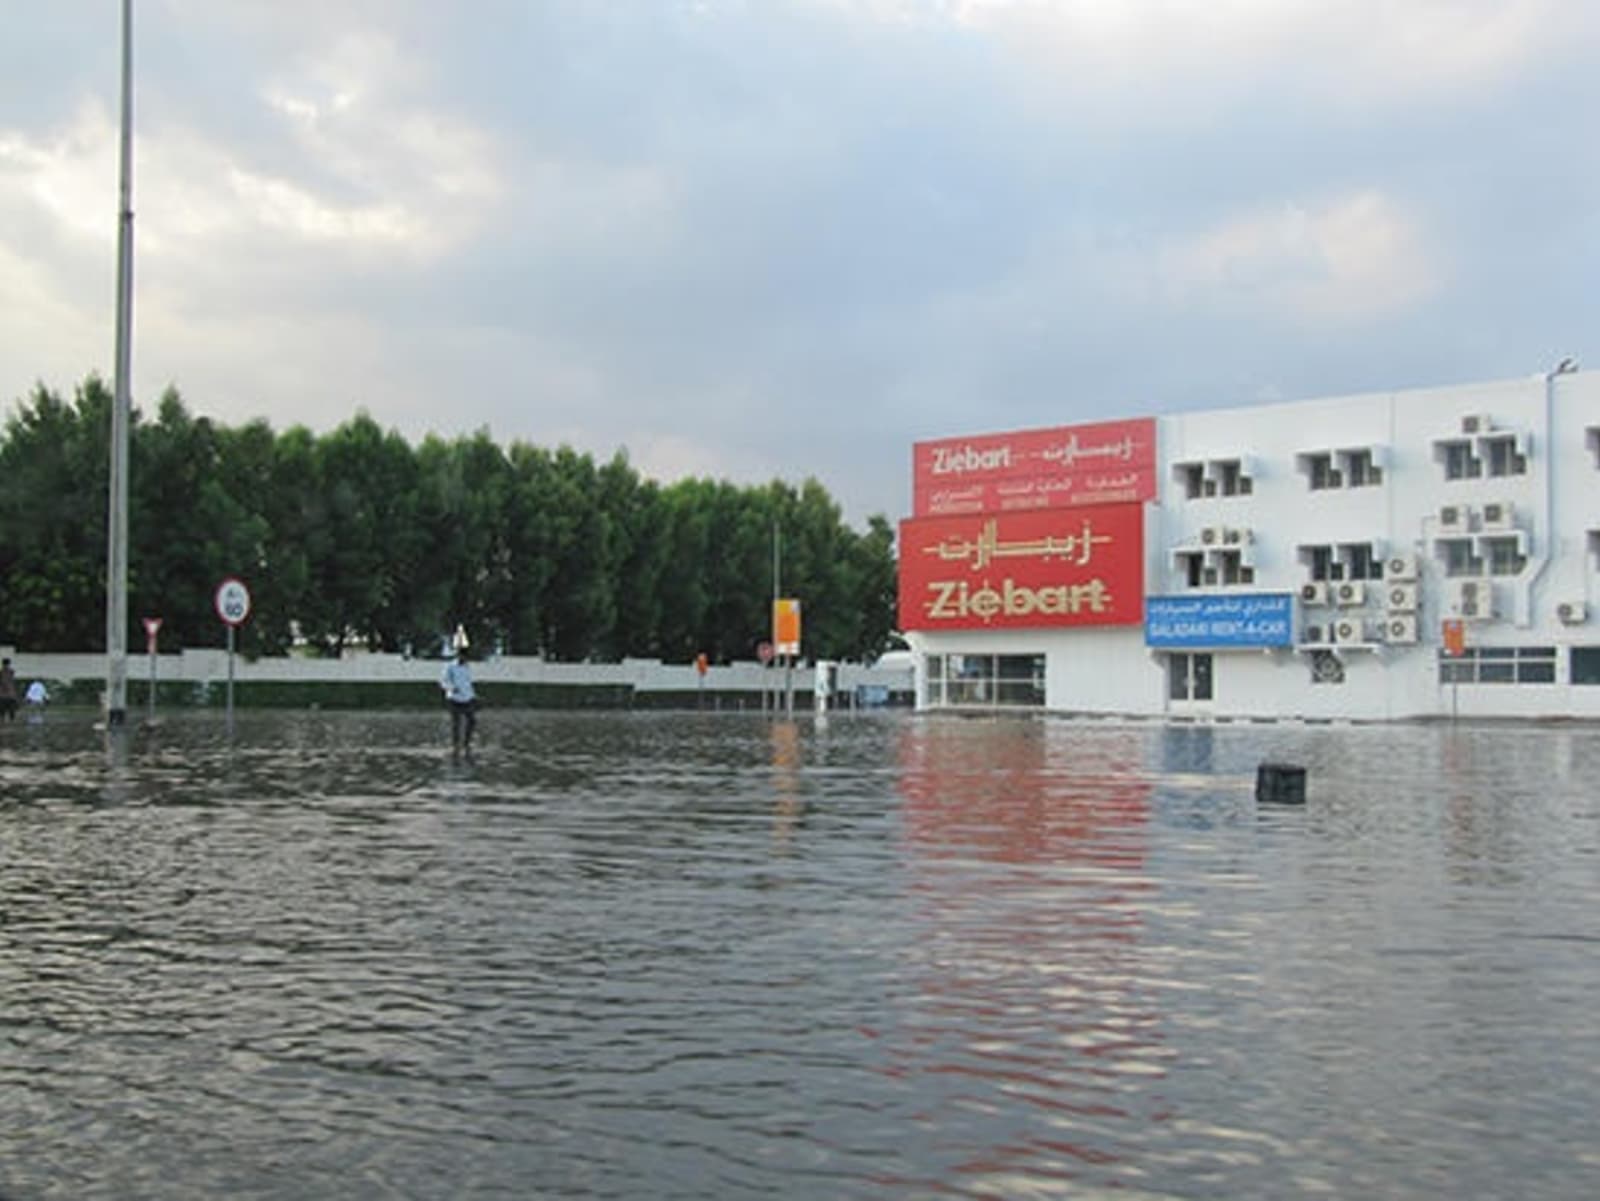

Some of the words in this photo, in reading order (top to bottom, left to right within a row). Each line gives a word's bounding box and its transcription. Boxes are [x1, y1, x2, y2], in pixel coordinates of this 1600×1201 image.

[931, 445, 1011, 476] Ziebart
[930, 517, 1103, 571] زيبارت
[926, 578, 1106, 622] Ziebart
